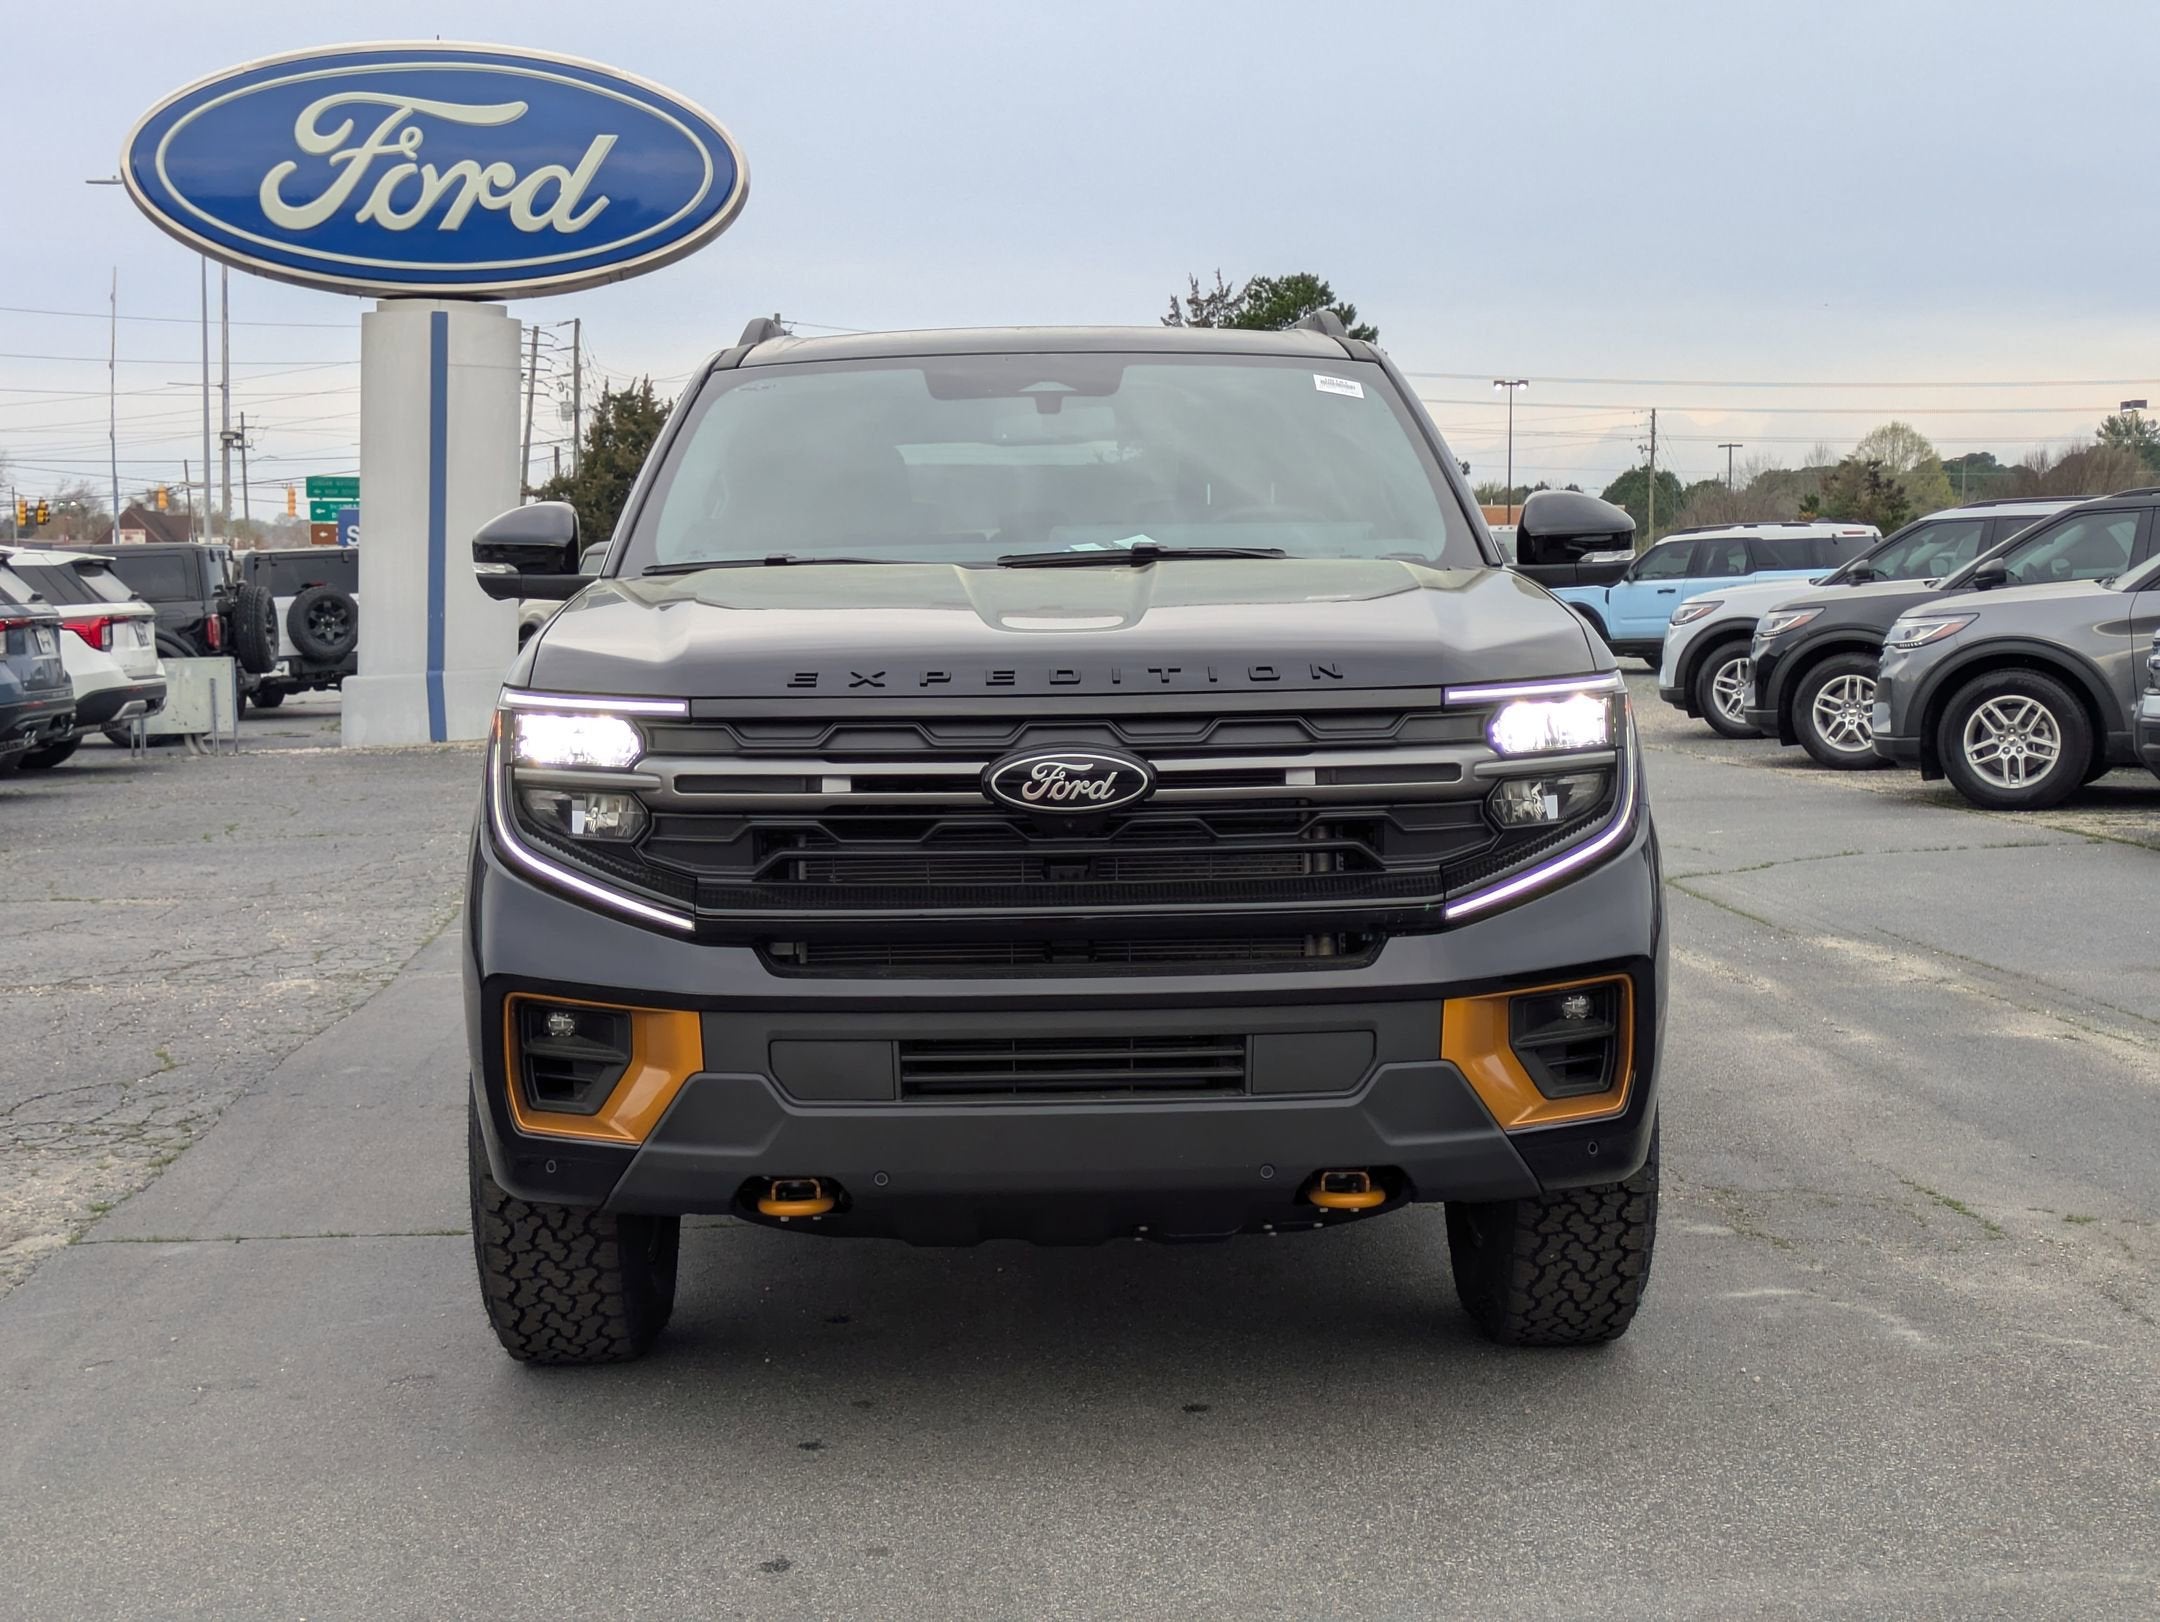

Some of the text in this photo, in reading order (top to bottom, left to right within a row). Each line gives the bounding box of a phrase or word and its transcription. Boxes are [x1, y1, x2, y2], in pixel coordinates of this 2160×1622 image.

[260, 91, 619, 233] Ford
[787, 662, 1344, 688] EXPEDITION
[1021, 761, 1118, 801] Ford
